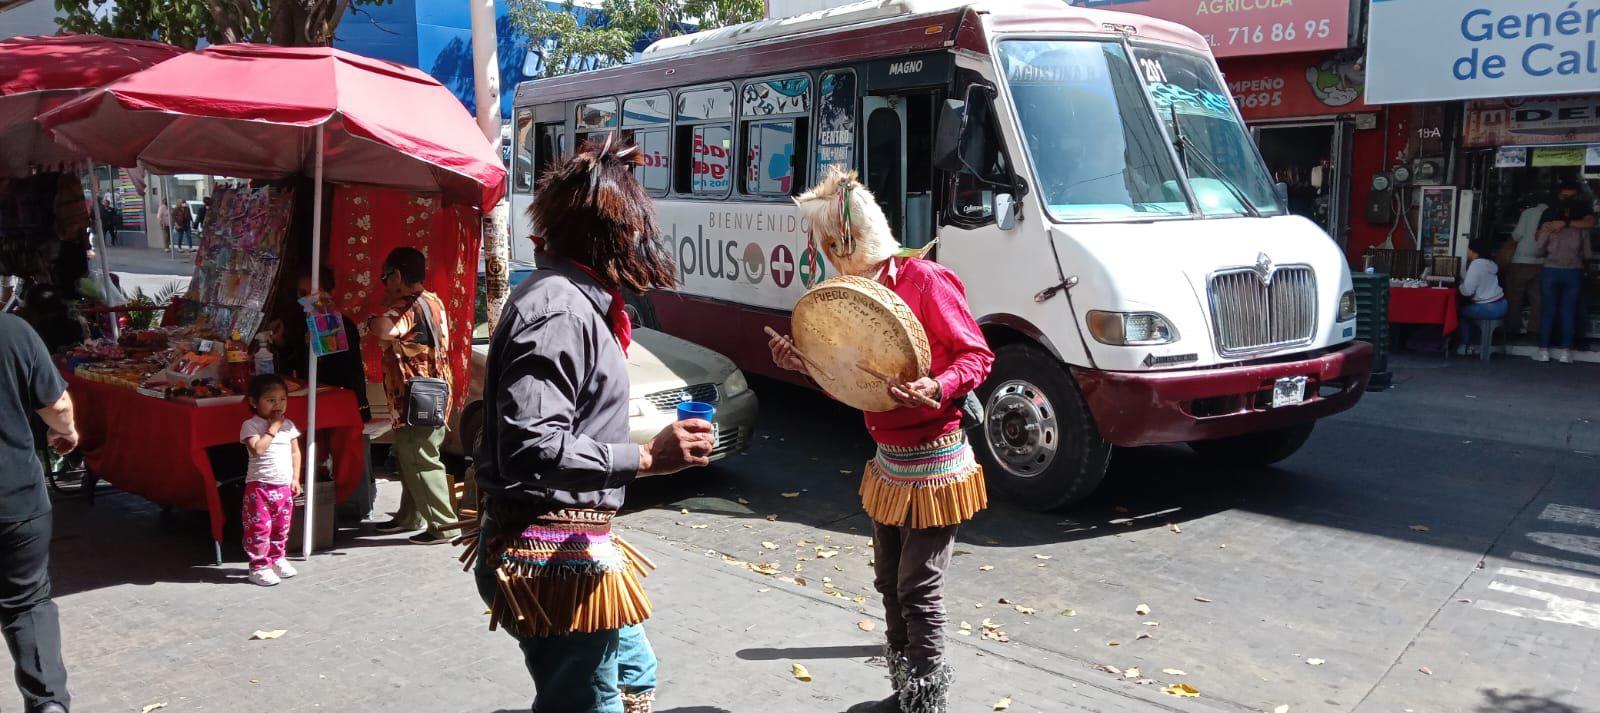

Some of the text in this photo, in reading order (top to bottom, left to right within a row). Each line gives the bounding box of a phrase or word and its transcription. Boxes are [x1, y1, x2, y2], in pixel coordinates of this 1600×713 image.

[1228, 25, 1263, 45] 716
[1271, 22, 1296, 41] 86
[1305, 19, 1330, 39] 95
[889, 60, 923, 75] MAGNO
[1452, 40, 1598, 80] de Cal
[1140, 58, 1168, 82] 201
[1230, 77, 1285, 92] MPEÑO
[1516, 106, 1600, 122] DE
[821, 130, 849, 145] CENTRO
